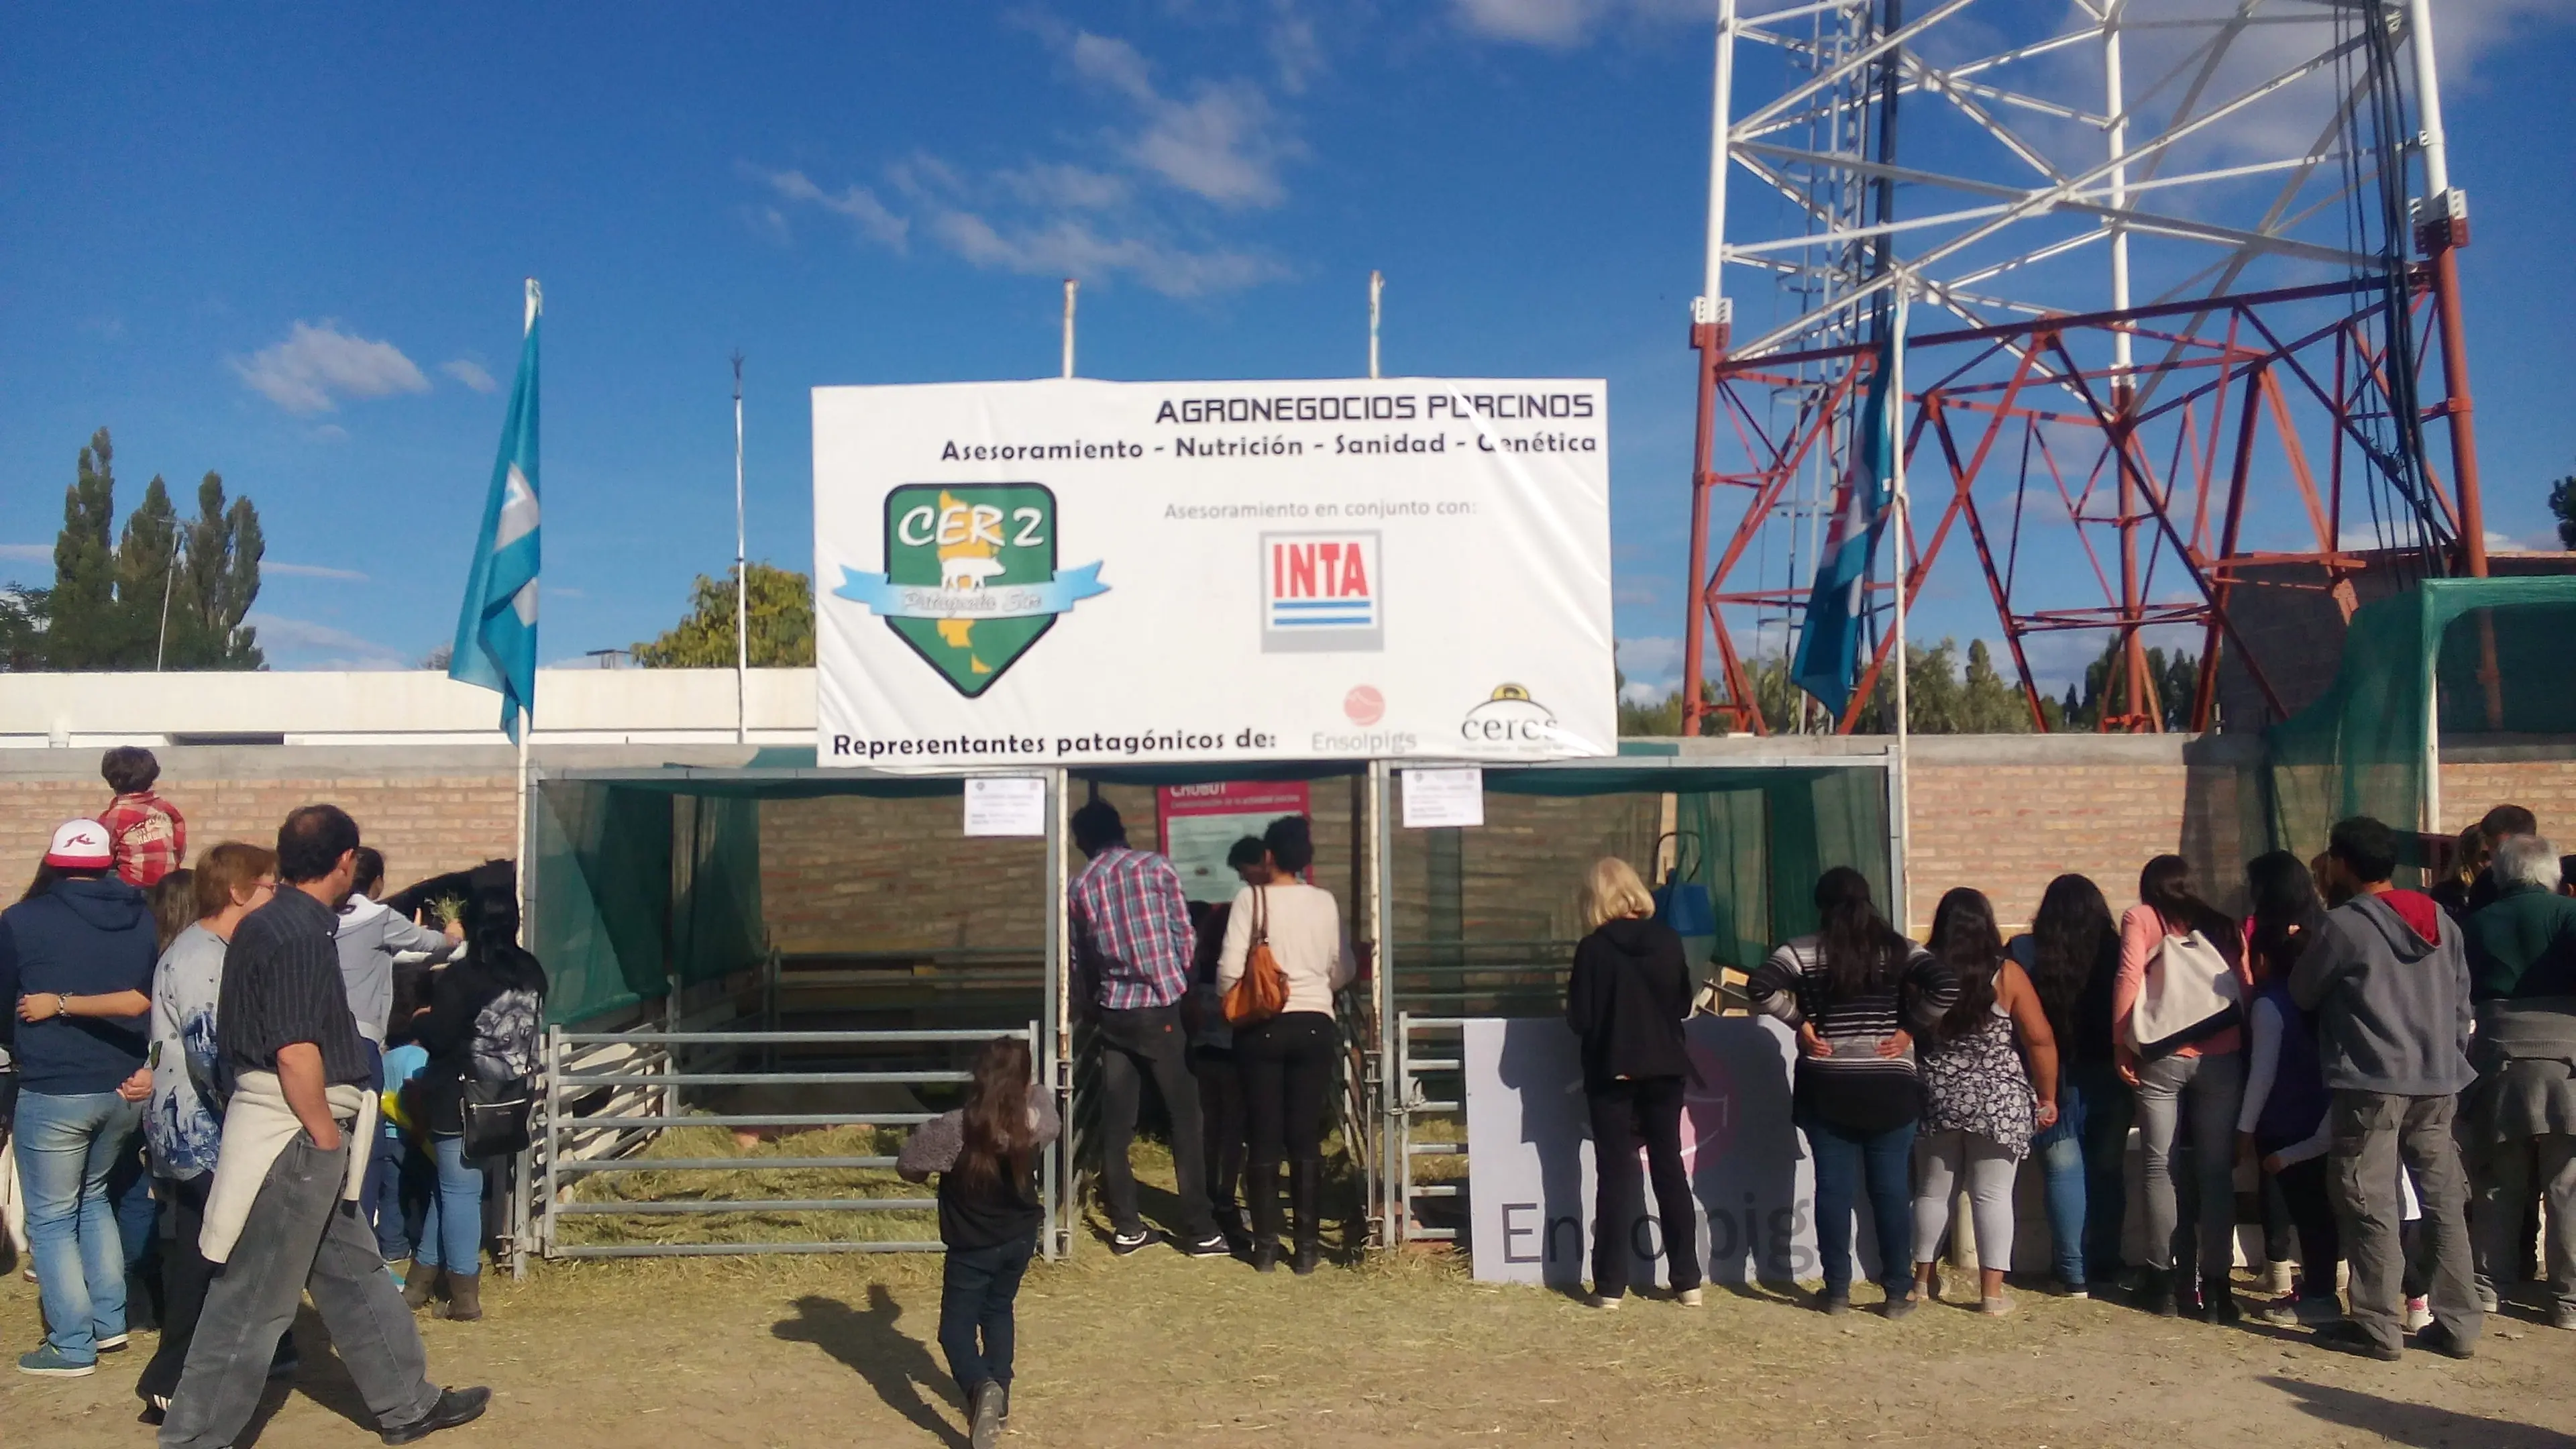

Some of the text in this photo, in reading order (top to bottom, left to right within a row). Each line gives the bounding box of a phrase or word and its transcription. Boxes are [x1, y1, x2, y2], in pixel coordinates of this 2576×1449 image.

[1155, 394, 1594, 424] AGRONEGOCIOS PORCINOS
[941, 439, 1144, 461] Asesoramiento
[1175, 435, 1303, 457] Nutrición
[1335, 433, 1446, 455] Sanidad
[1164, 498, 1477, 520] Asesoramiento en conjunto con:
[898, 504, 1045, 547] CER 2
[1273, 543, 1369, 597] INTA
[833, 728, 1277, 760] Representantes patagónicos de:
[1311, 732, 1417, 754] Ensolpigs
[1501, 1191, 1815, 1276] Enopig
